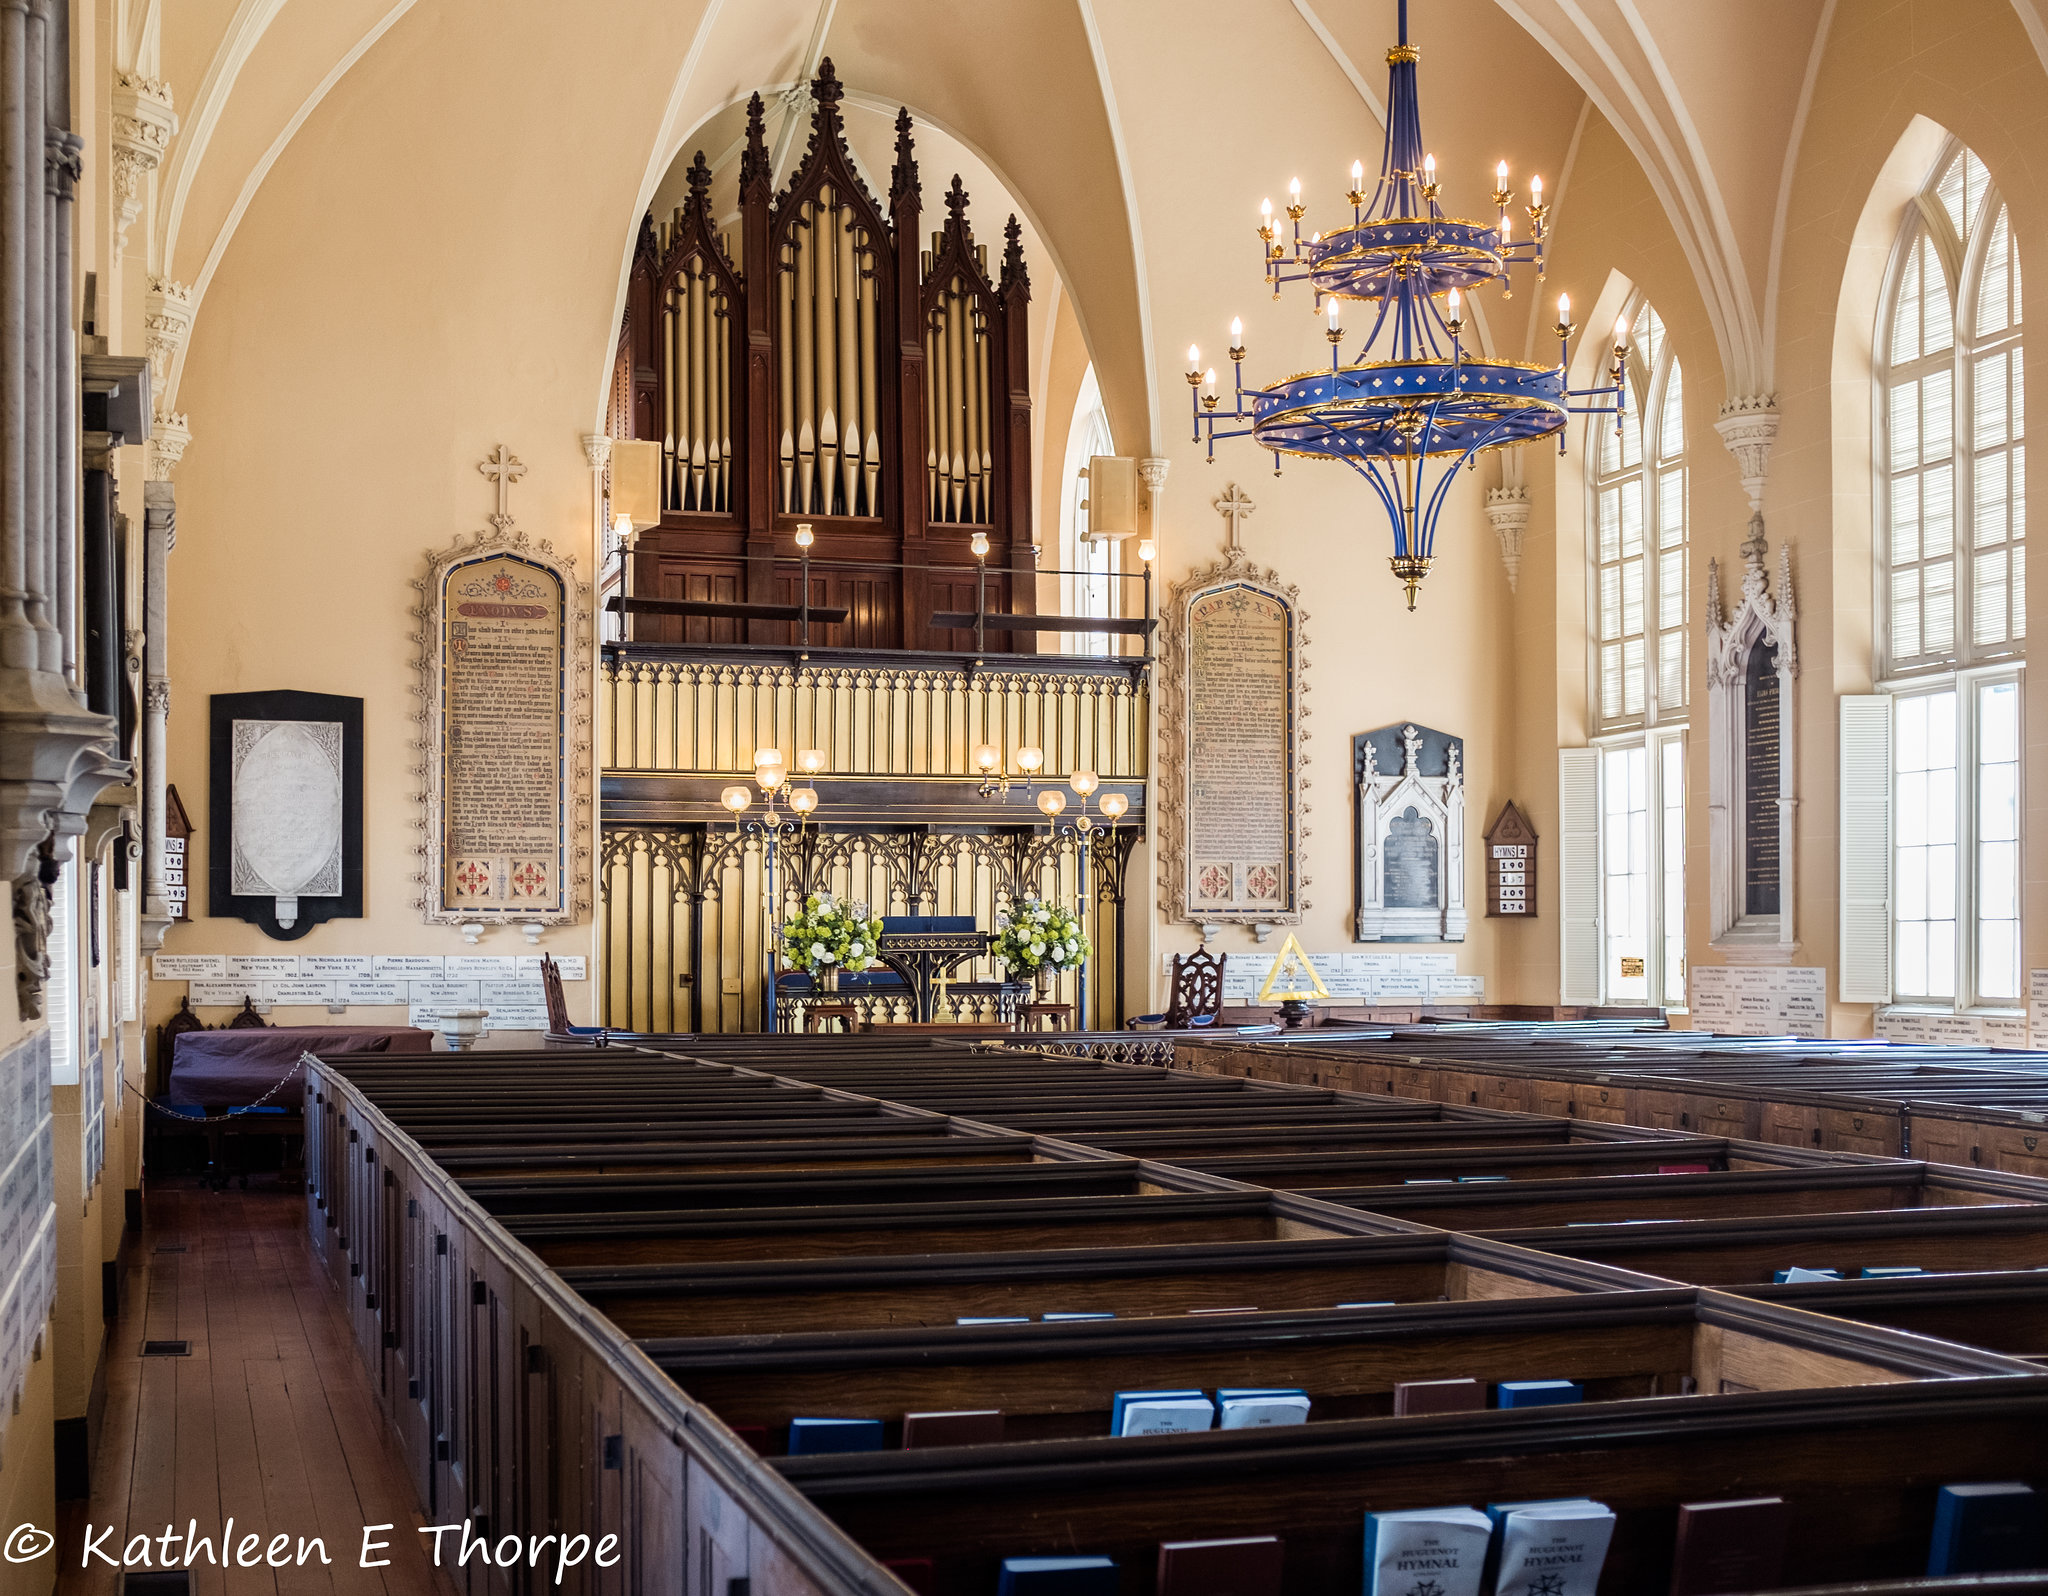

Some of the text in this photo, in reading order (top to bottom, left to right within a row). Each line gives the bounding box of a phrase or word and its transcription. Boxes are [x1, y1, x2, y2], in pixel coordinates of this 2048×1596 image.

[1494, 847, 1516, 856] HYMNS
[1402, 1548, 1460, 1557] HUGUENOT
[1530, 1544, 1584, 1554] HUGUENOT
[1397, 1559, 1460, 1571] HYMNAL
[1524, 1555, 1584, 1567] HYMNAL
